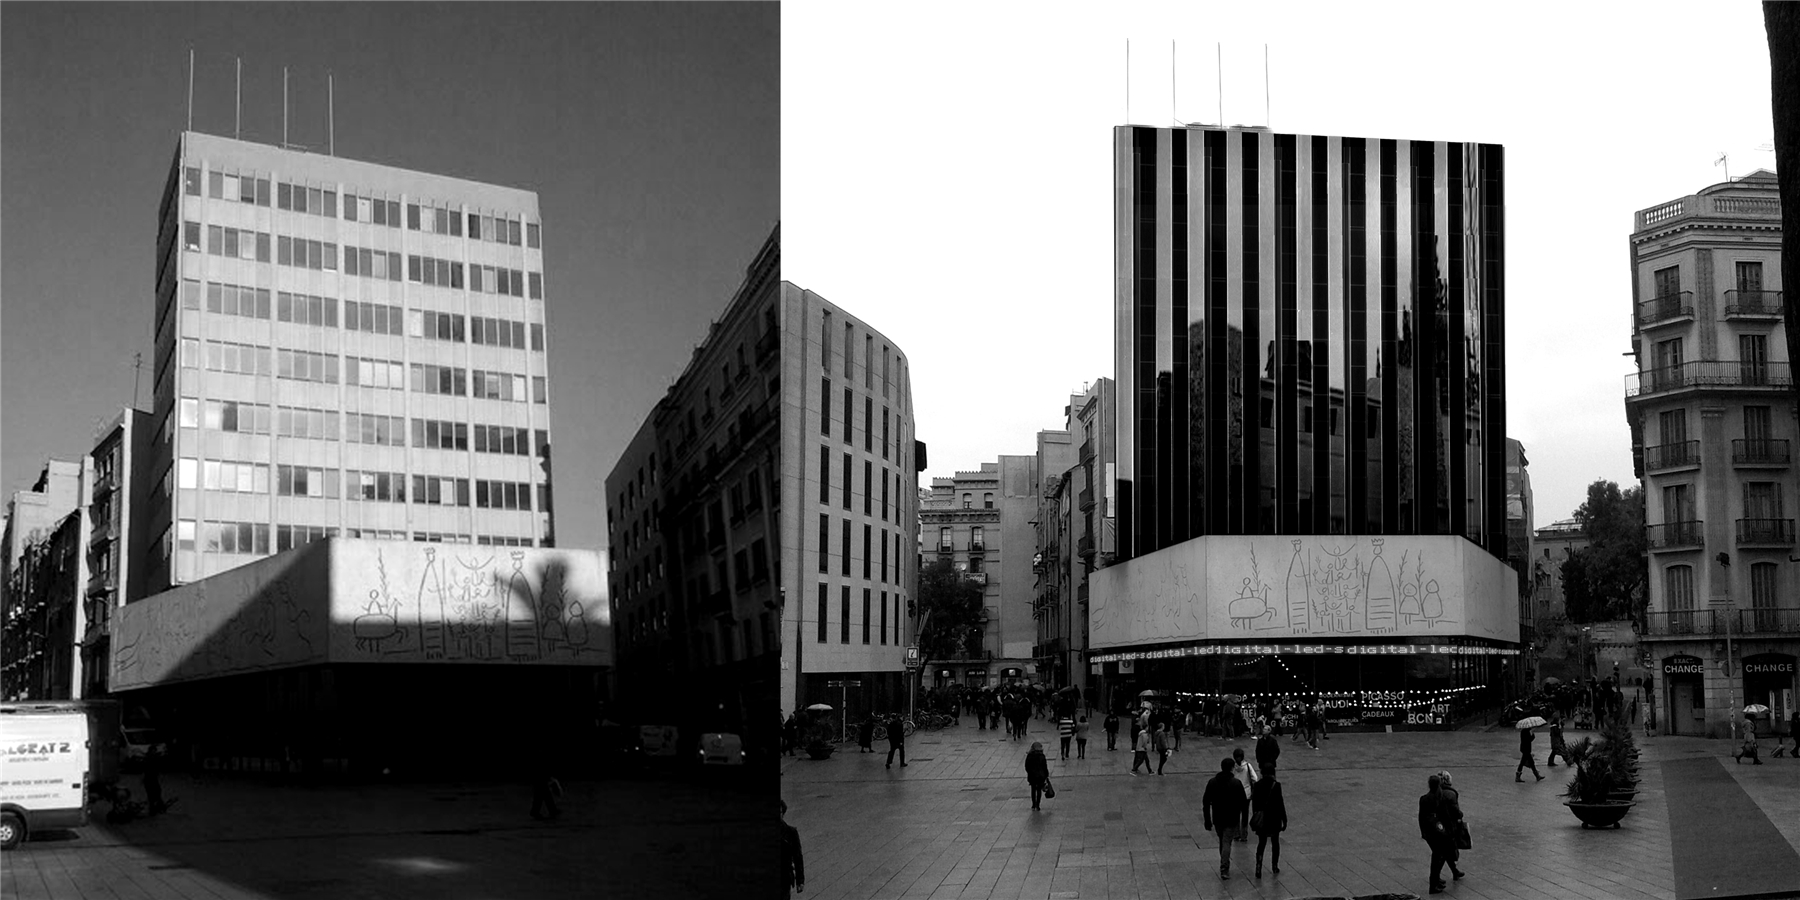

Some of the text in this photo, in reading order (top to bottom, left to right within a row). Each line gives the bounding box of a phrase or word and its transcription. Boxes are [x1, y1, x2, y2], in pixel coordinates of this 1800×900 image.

[1664, 664, 1704, 674] CHANGE
[1745, 663, 1793, 673] CHANGE
[1361, 692, 1405, 701] PICASSO
[1325, 699, 1349, 709] AUDI
[1430, 704, 1450, 713] ART
[1407, 713, 1434, 724] BCN
[59, 742, 72, 753] 2
